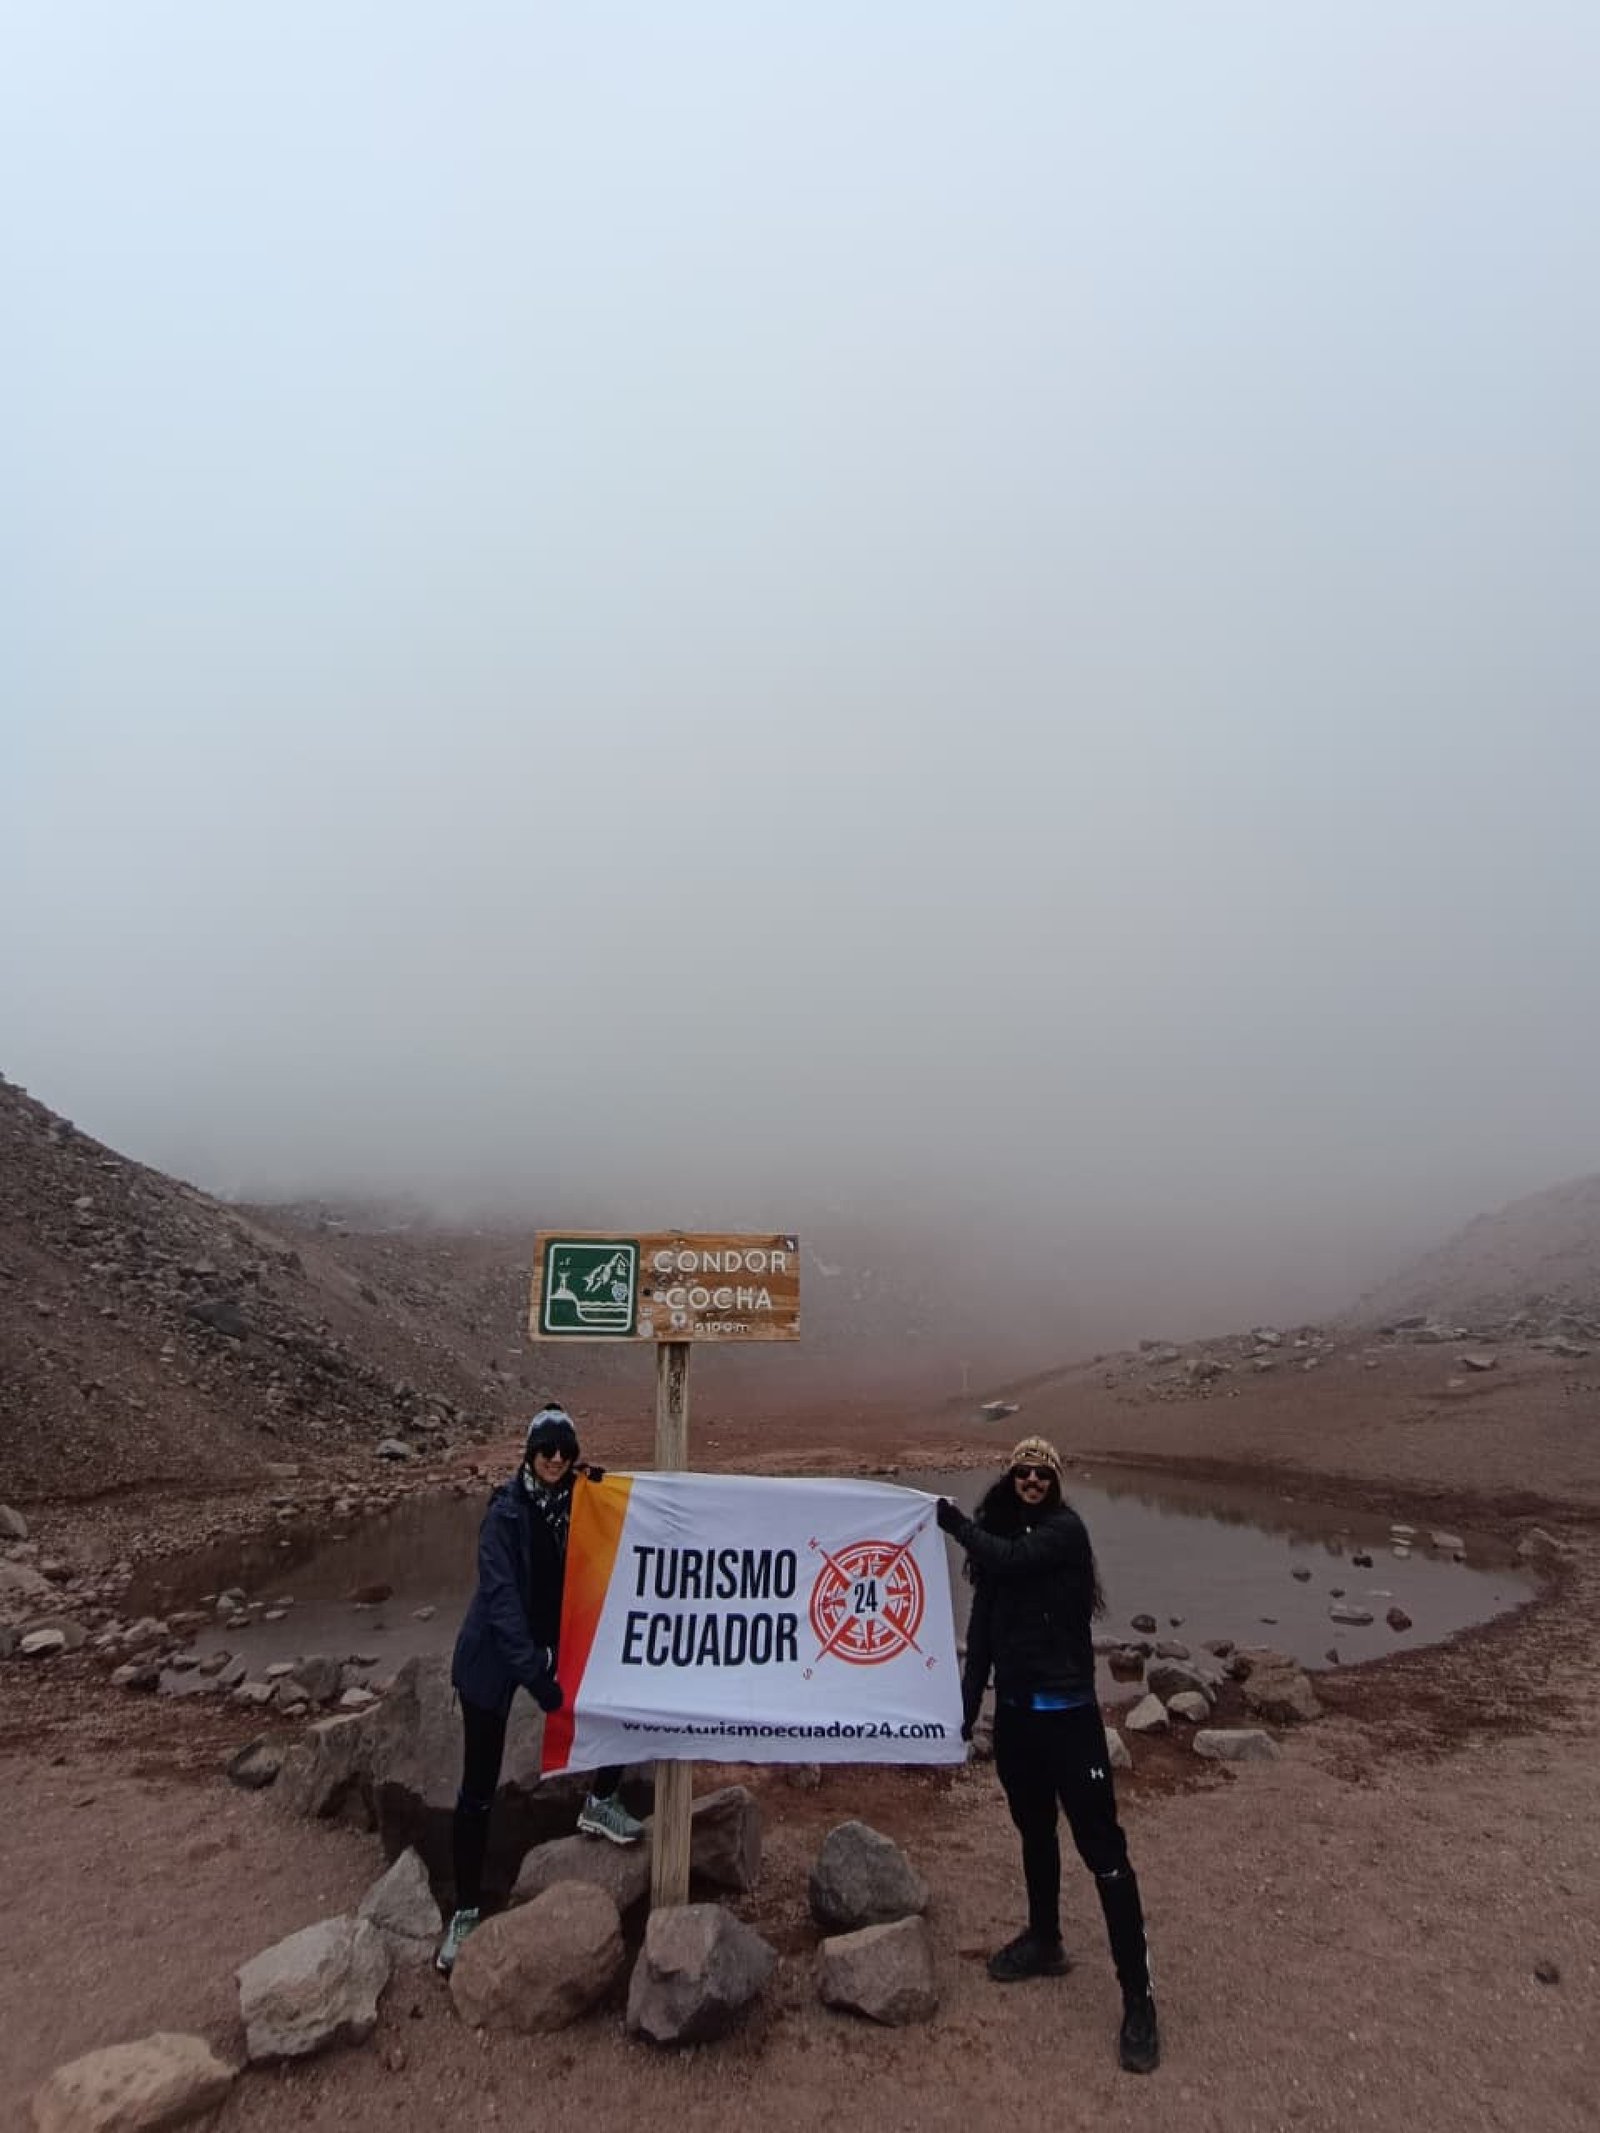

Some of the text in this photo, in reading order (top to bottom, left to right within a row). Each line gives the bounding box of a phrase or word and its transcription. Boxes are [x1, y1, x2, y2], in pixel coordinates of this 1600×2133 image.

[653, 1250, 787, 1273] CONDOR
[665, 1287, 773, 1310] COCHA
[632, 1545, 797, 1599] TURISMO
[854, 1579, 878, 1614] 24
[621, 1611, 798, 1667] ECUADOR
